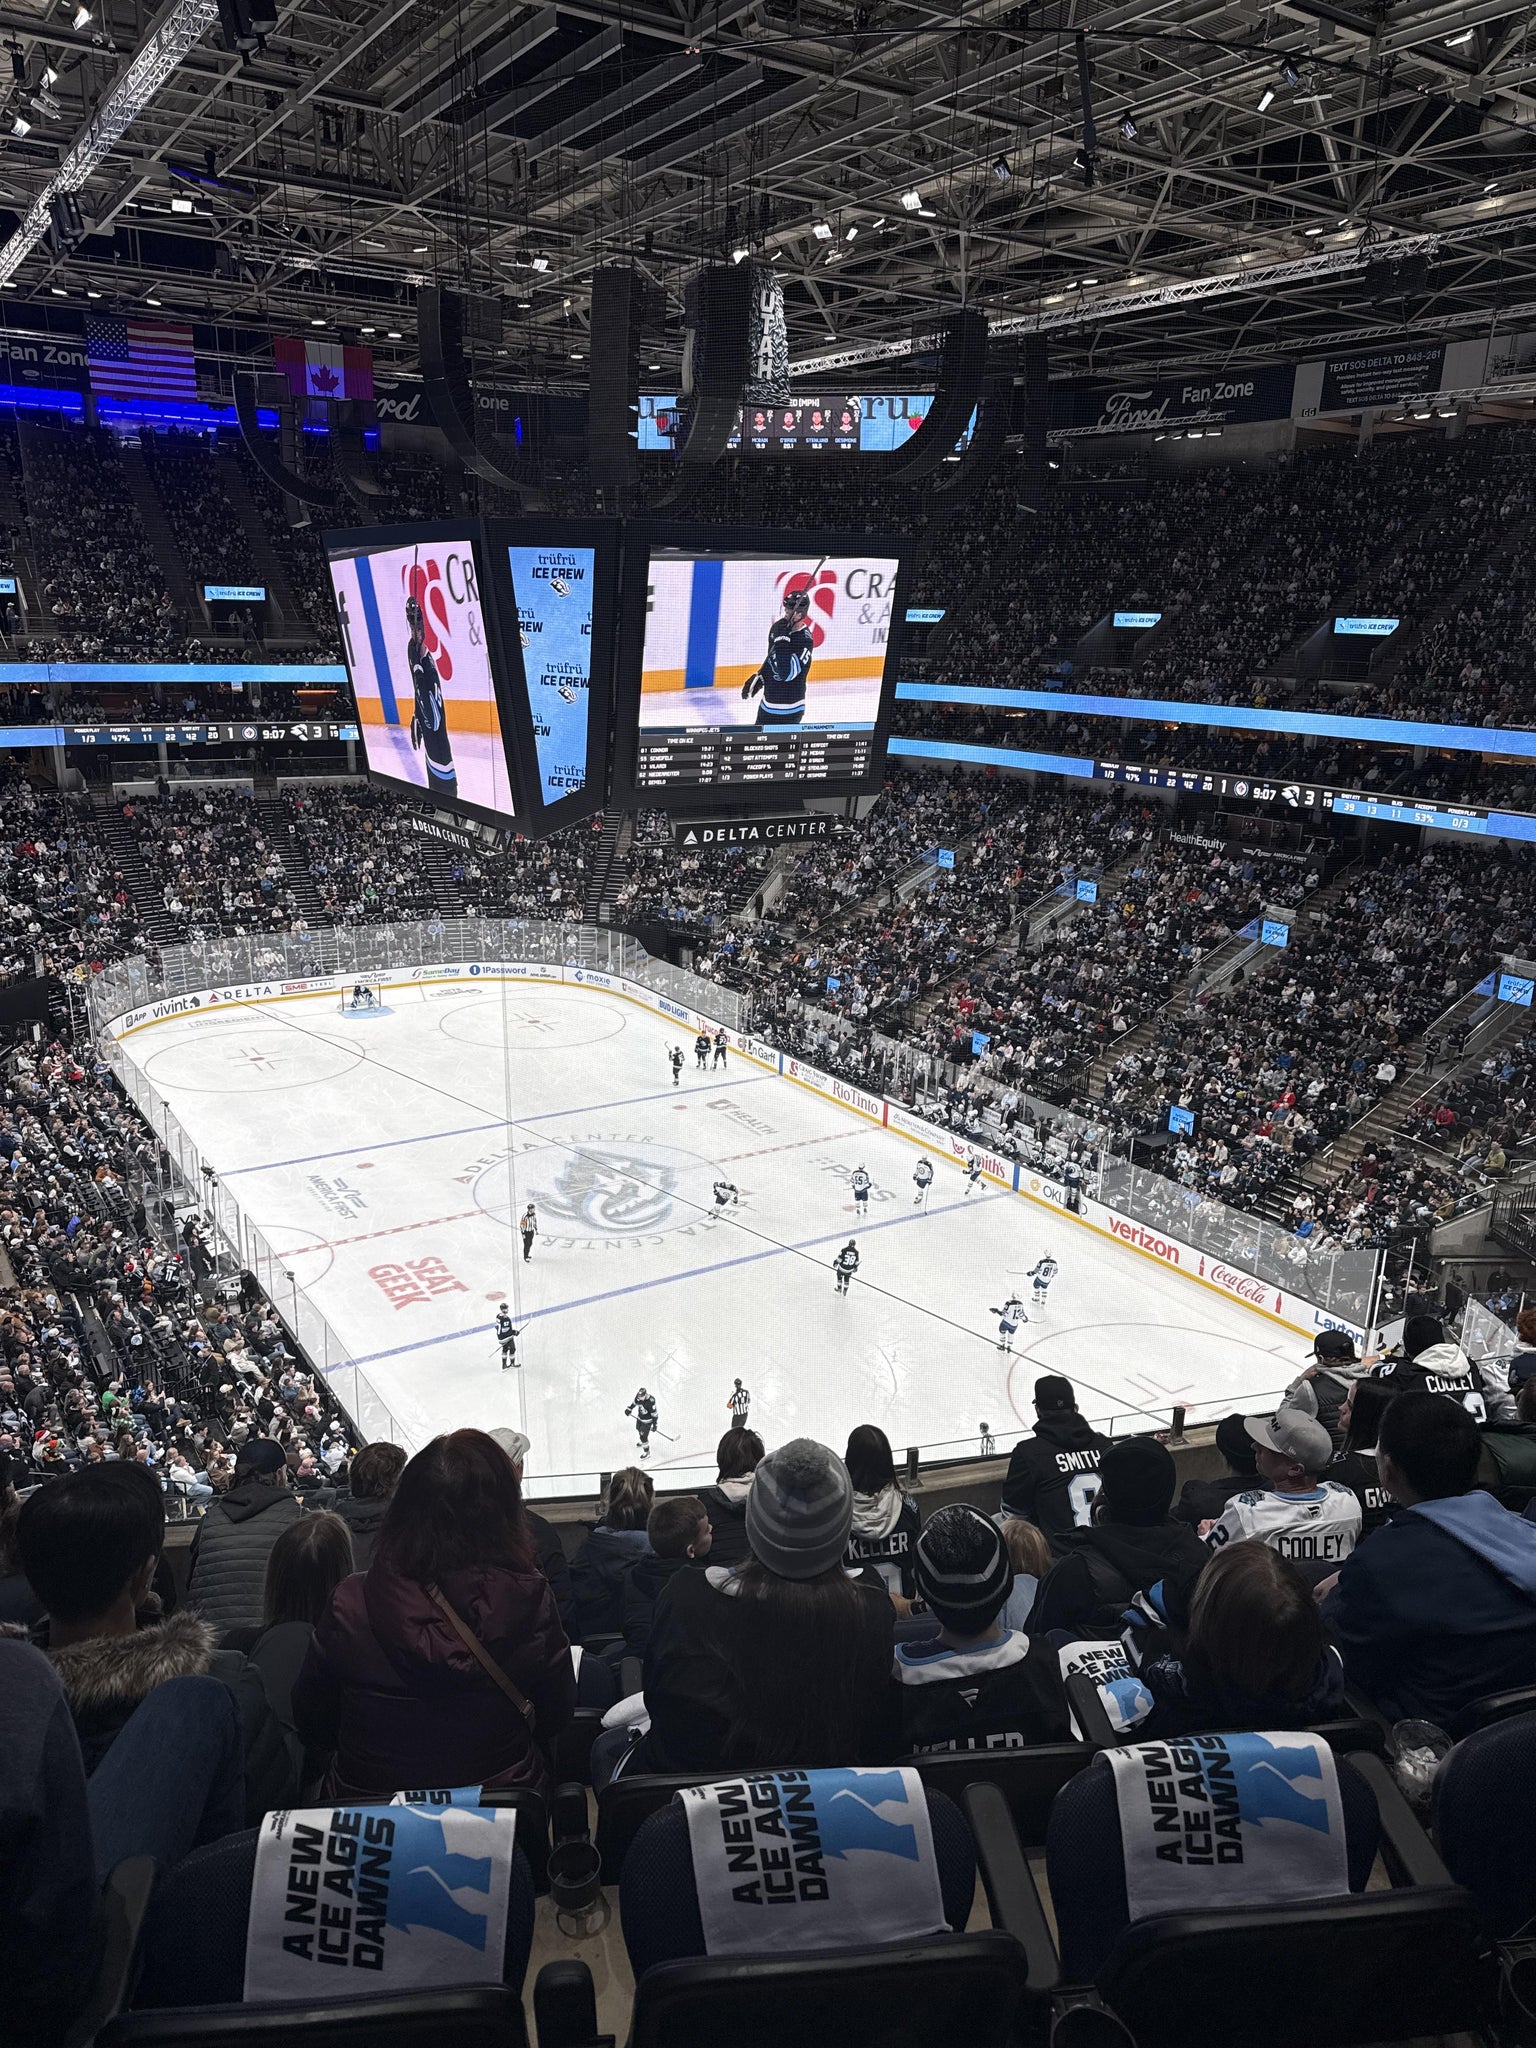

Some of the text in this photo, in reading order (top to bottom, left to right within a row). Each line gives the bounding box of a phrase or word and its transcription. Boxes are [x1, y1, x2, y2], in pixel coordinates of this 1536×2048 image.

[758, 290, 776, 379] UTAH
[42, 345, 89, 367] Zon
[1329, 355, 1405, 373] TEXT SOS DELTA TO
[1182, 382, 1254, 403] Fan Zone
[538, 553, 576, 565] trüfrü
[532, 567, 584, 579] ICE CREW
[858, 602, 875, 625] &
[800, 647, 811, 664] 15
[546, 662, 583, 675] trüfrü
[540, 675, 590, 688] ICE CREW
[82, 735, 95, 743] 1/3
[111, 734, 130, 742] 47%
[227, 727, 234, 740] 1
[262, 729, 286, 739] 9:07
[313, 726, 322, 738] 3
[548, 776, 564, 787] ICE
[1104, 770, 1115, 779] 1/3
[1125, 773, 1140, 782] 47%
[1149, 776, 1157, 784] 11
[1166, 778, 1176, 787] 22
[1183, 781, 1194, 790] 42
[1202, 782, 1213, 791] 20
[1221, 779, 1227, 793] 1
[1253, 787, 1276, 800] 9:07
[1304, 790, 1315, 806] 3
[1322, 798, 1333, 807] 19
[1343, 802, 1355, 812] 39
[1367, 806, 1377, 815] 13
[1391, 809, 1401, 818] 11
[1414, 813, 1434, 824] 53%
[1452, 818, 1469, 828] 0/3
[418, 820, 470, 849] DELTA CENTER
[703, 822, 826, 842] DELTA CENTER
[1169, 832, 1226, 851] HealthEquity
[423, 967, 460, 975] SameDay
[483, 967, 527, 975] 1Password
[285, 982, 308, 991] SME
[586, 974, 611, 985] moxie
[224, 985, 272, 1000] DELTA
[133, 1011, 147, 1023] App
[659, 1000, 689, 1020] BUD LIGHT
[471, 1133, 654, 1173] DELTA CENTER
[306, 1175, 335, 1204] AMERICA
[332, 1200, 358, 1220] FIRST
[1108, 1216, 1180, 1265] verizon
[843, 1254, 856, 1265] 38
[404, 1256, 470, 1296] SEAT
[367, 1263, 432, 1311] GEEK
[1210, 1264, 1270, 1304] Coca-Cola
[1314, 1310, 1364, 1346] Layton
[1055, 1449, 1101, 1473] SMITH
[848, 1532, 909, 1560] KELLER
[1278, 1533, 1344, 1560] COOLEY
[1067, 1648, 1124, 1674] A NEW
[1136, 1746, 1183, 1865] A NEW
[1164, 1738, 1214, 1865] ICE AGE
[1194, 1735, 1244, 1864] DAWNS
[744, 1773, 797, 1905] ICE AGE
[774, 1770, 829, 1902] DAWNS
[714, 1784, 763, 1905] A NEW
[282, 1823, 325, 1962] A NEW
[317, 1811, 362, 1966] ICE AGE
[353, 1816, 396, 1971] DAWNS
